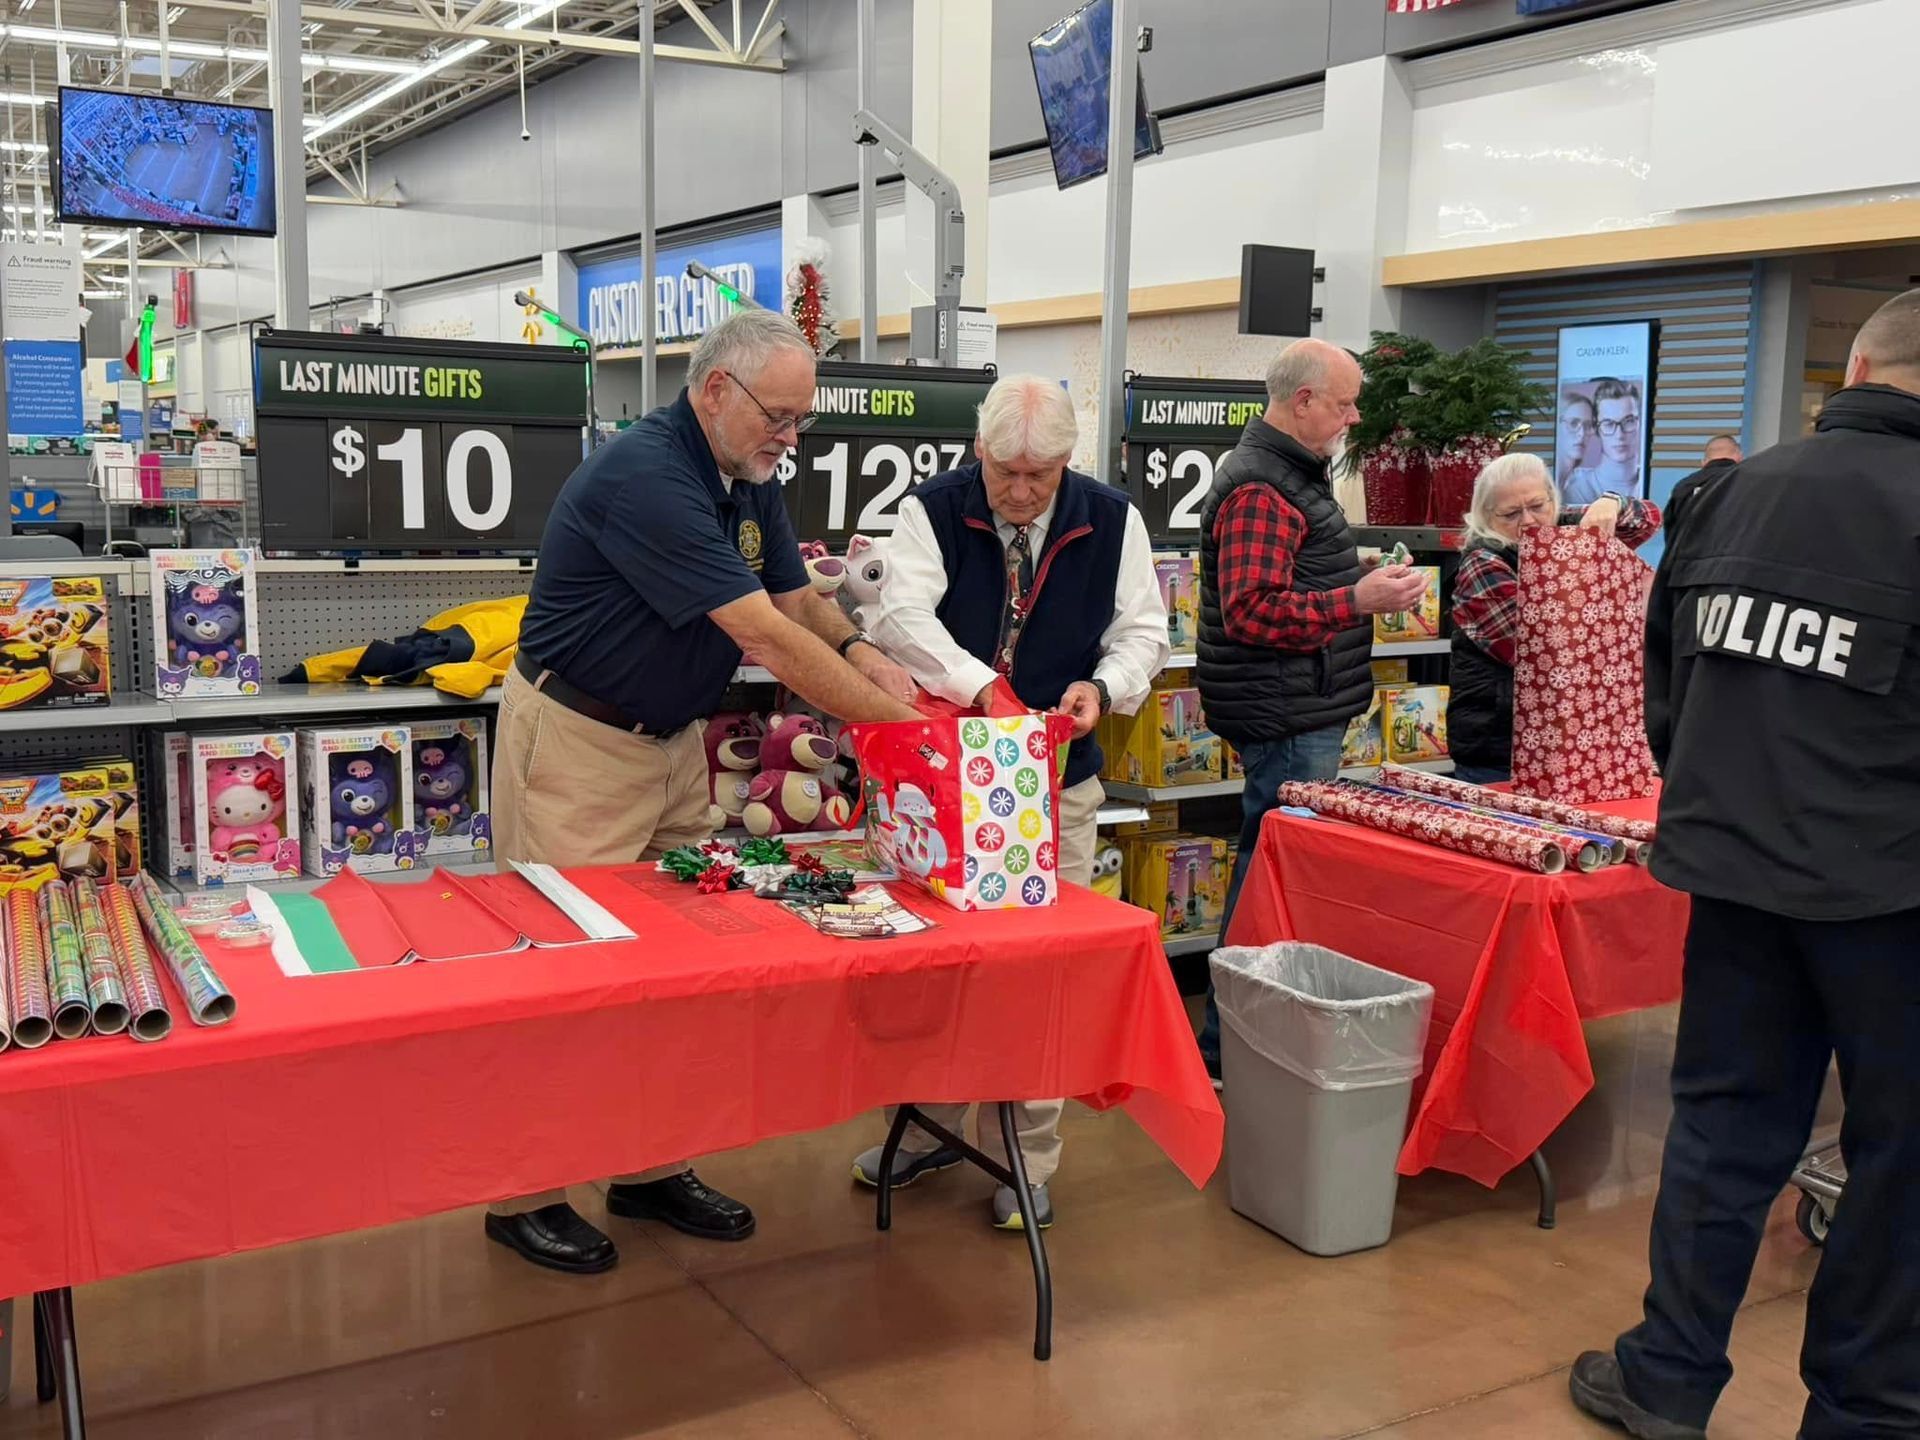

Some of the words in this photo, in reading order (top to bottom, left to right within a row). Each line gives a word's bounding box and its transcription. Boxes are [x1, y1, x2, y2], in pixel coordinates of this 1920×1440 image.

[589, 275, 679, 342] CUSTOER
[12, 353, 37, 361] Alcohol
[1576, 346, 1605, 358] CALVIN
[1605, 345, 1630, 356] KLEIN
[280, 360, 333, 393] LAST
[336, 363, 420, 397] MINUTE
[424, 367, 482, 399] GIFTS
[871, 389, 915, 416] GIFTS
[1142, 399, 1175, 424] LAST
[1175, 401, 1227, 425] MINUTE
[1227, 402, 1264, 426] GIFTS
[332, 425, 512, 531] $10
[1146, 447, 1233, 528] $2
